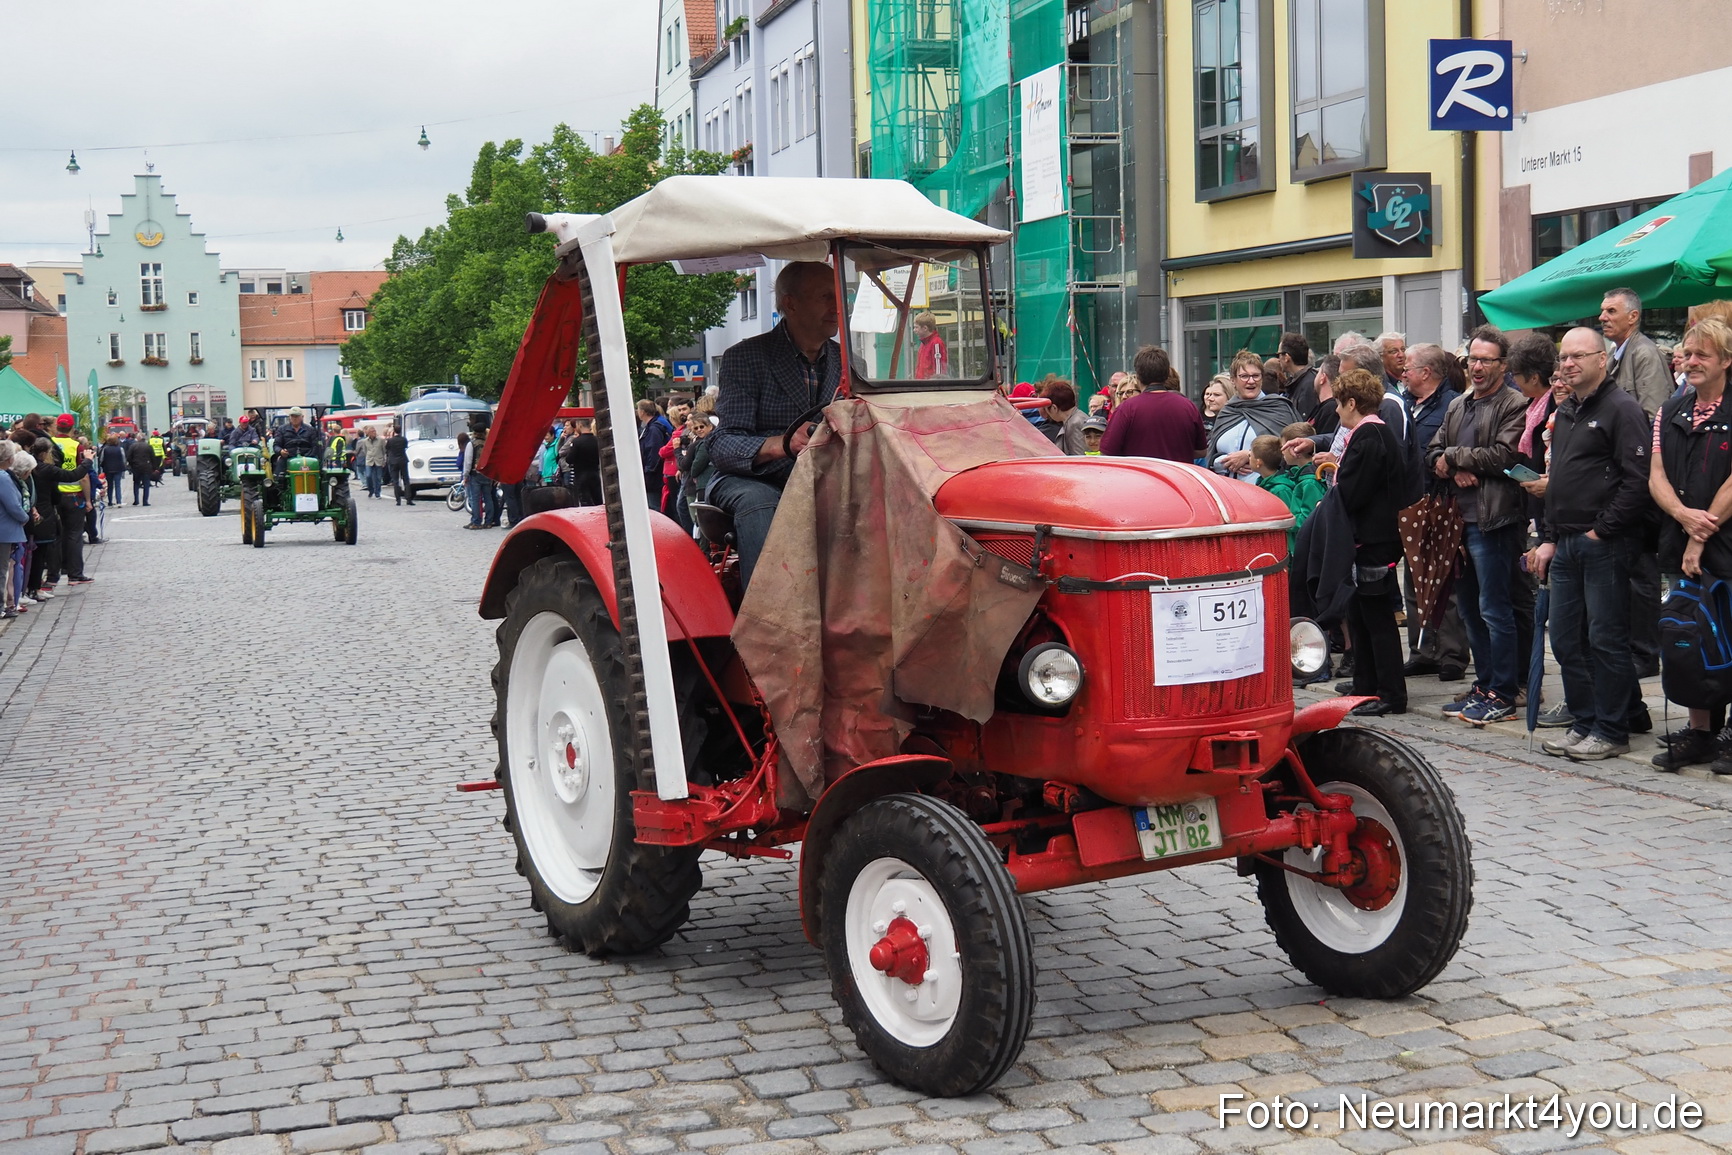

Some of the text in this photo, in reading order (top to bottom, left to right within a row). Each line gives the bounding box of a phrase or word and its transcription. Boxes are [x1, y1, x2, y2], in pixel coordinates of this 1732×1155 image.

[1521, 146, 1581, 172] Unterer Markt 15
[1385, 195, 1413, 230] G2
[1213, 599, 1247, 622] 512
[1155, 824, 1211, 856] JT 82
